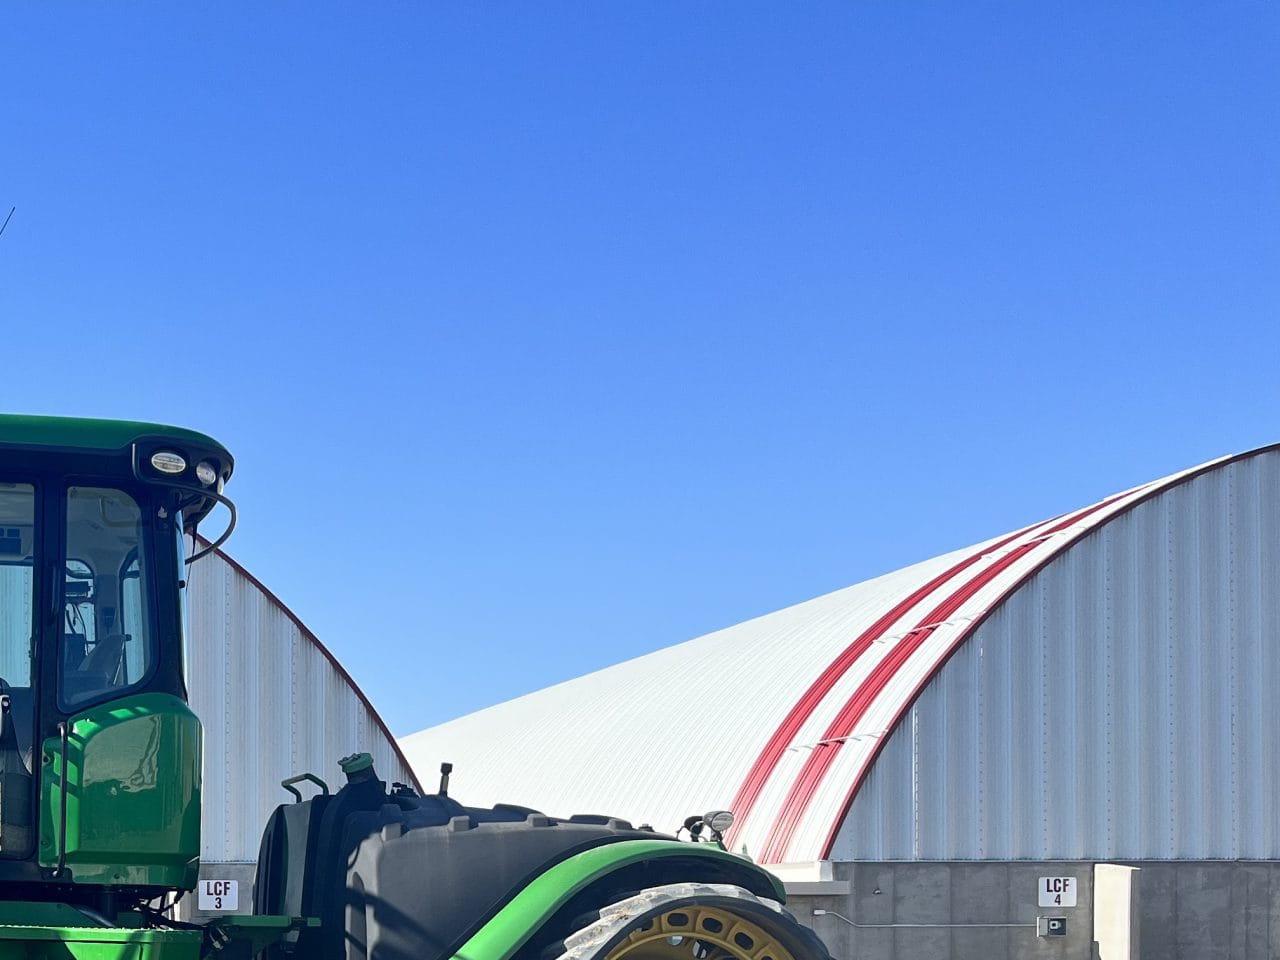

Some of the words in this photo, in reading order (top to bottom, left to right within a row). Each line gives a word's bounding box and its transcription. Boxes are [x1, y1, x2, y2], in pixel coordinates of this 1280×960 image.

[206, 881, 230, 896] LCF
[1046, 878, 1069, 893] LCF
[215, 897, 222, 909] 3
[1054, 894, 1061, 906] 4
